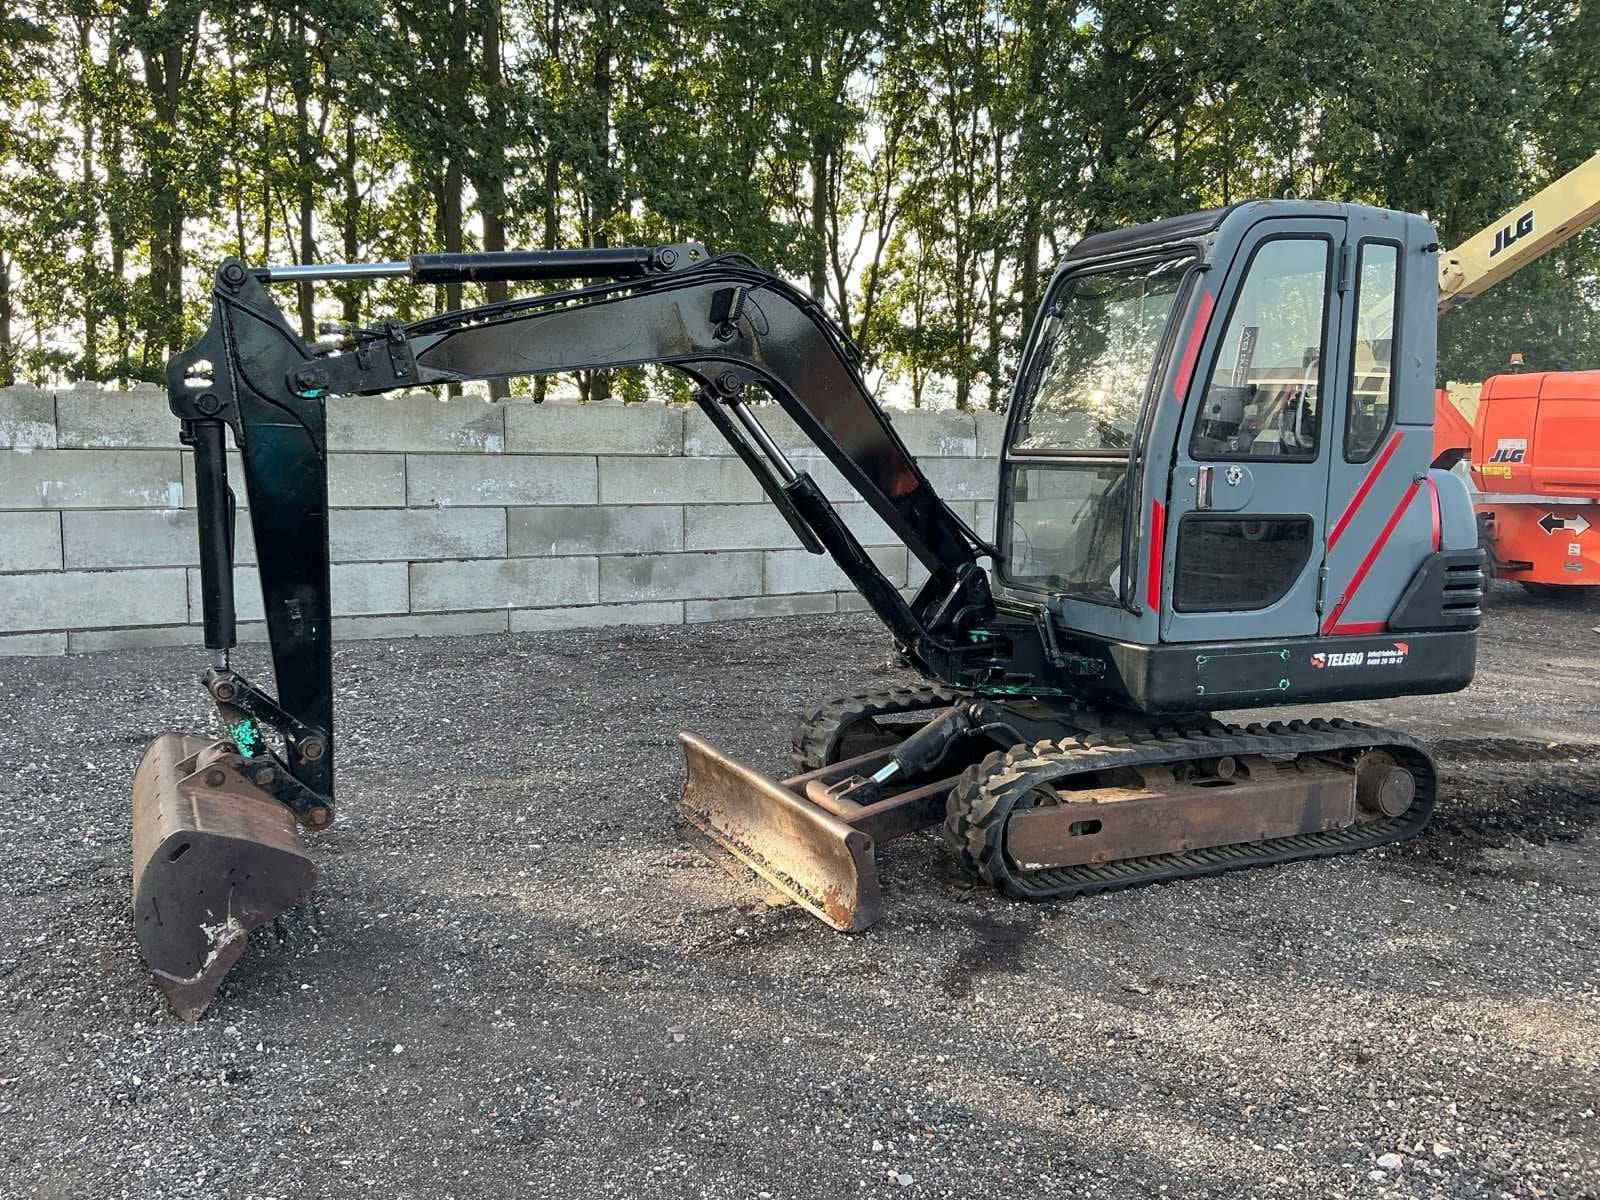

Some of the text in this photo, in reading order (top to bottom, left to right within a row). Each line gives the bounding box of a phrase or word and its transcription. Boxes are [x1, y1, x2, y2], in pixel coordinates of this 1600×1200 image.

[1489, 210, 1534, 259] JLG
[1489, 448, 1525, 463] JLG
[1327, 652, 1363, 666] TELEBO
